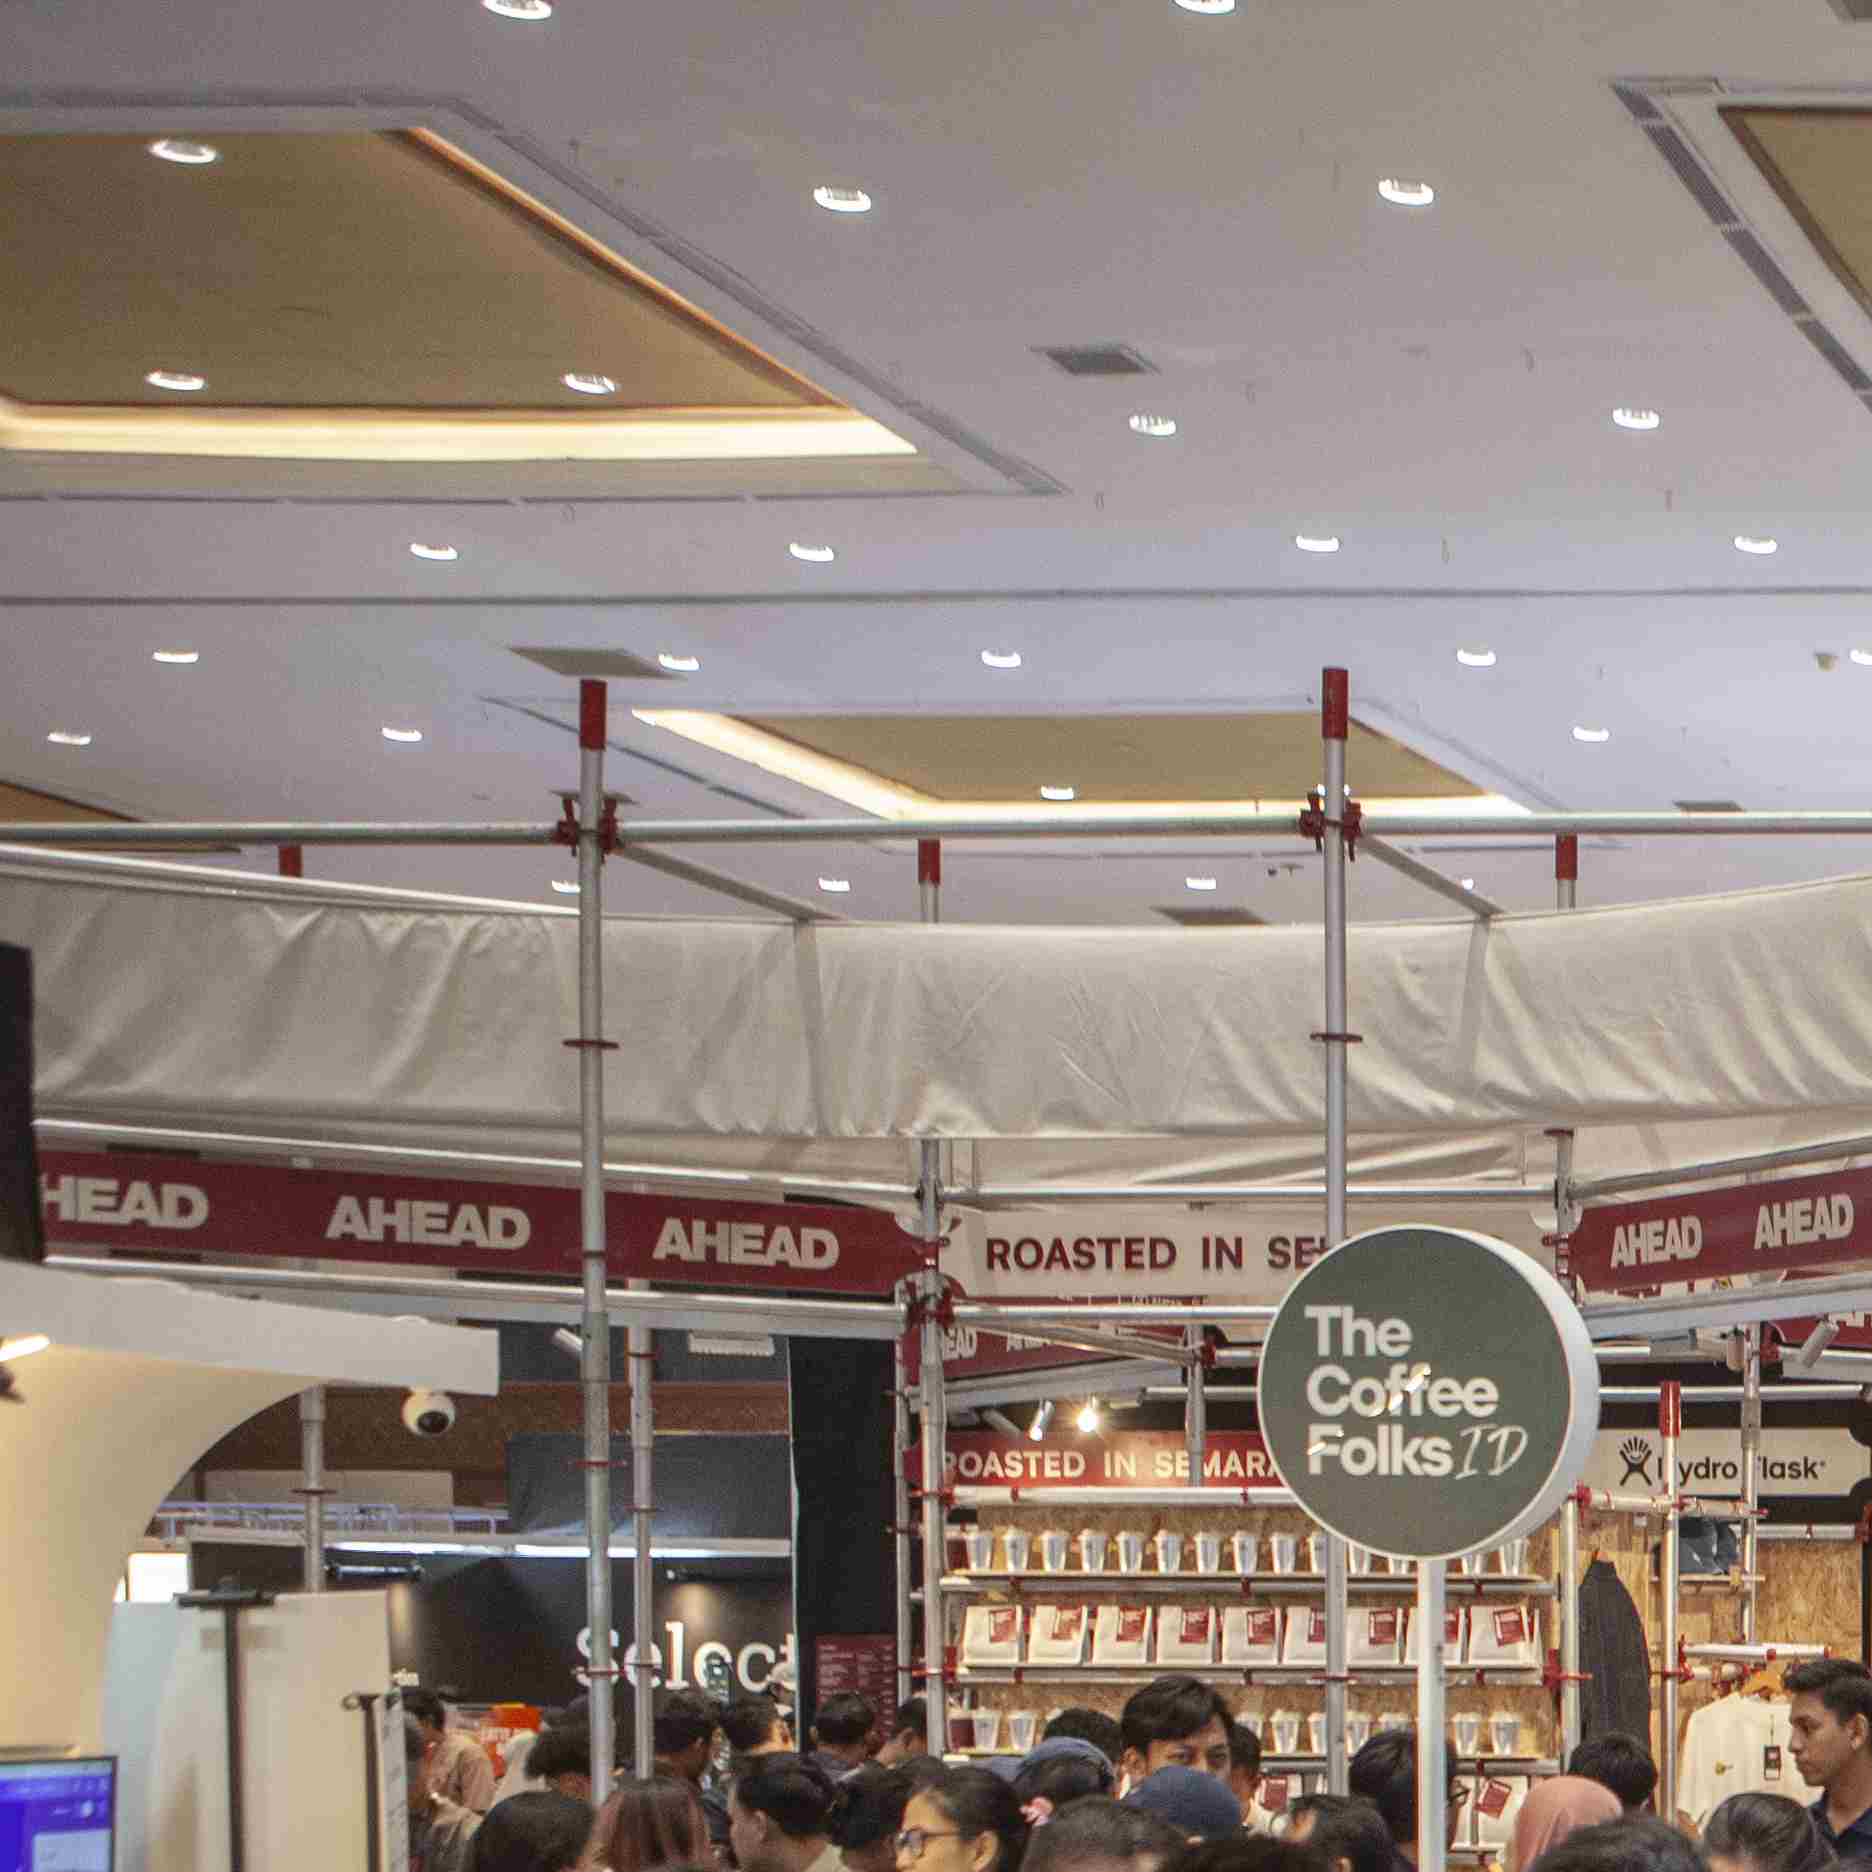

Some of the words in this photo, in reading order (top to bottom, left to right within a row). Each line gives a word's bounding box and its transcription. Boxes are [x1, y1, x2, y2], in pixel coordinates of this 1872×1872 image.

[42, 1175, 209, 1231] HEAD
[326, 1197, 532, 1251] AHEAD
[1755, 1193, 1854, 1249] AHEAD
[653, 1217, 840, 1271] AHEAD
[985, 1236, 1178, 1272] ROASTED
[1201, 1235, 1244, 1271] IN
[1611, 1214, 1703, 1269] AHEAD
[1304, 1305, 1412, 1357] The
[1305, 1363, 1499, 1419] Coffee
[1104, 1450, 1137, 1478] IN
[1307, 1424, 1454, 1477] Folks
[1453, 1423, 1528, 1481] ID
[1757, 1456, 1818, 1480] lask
